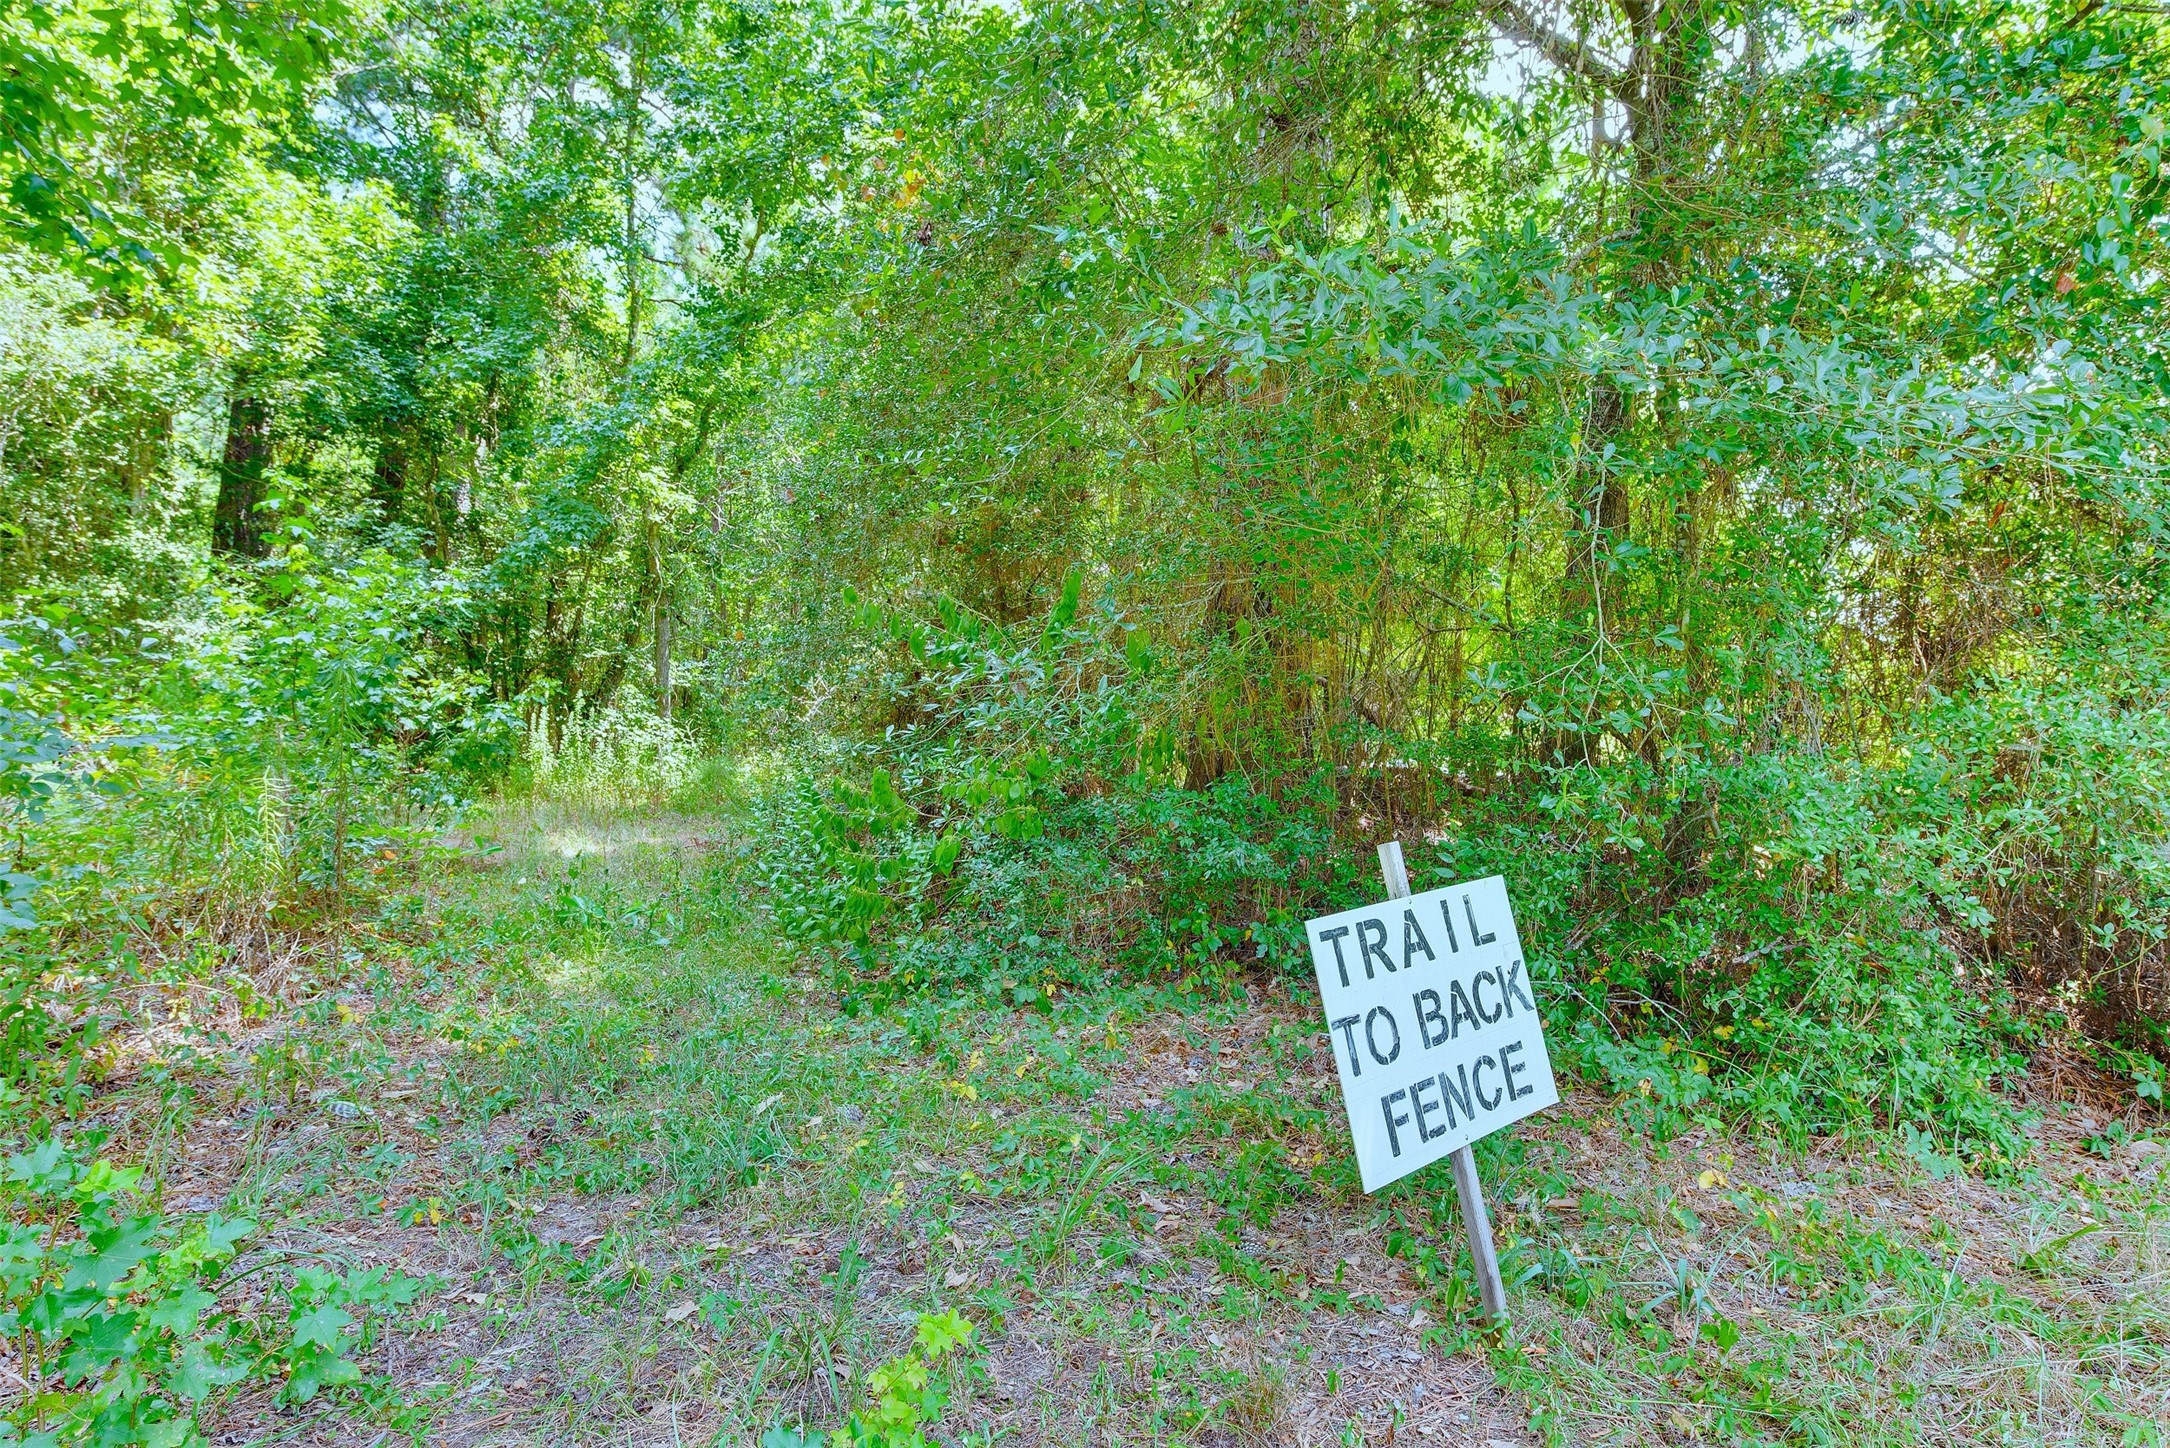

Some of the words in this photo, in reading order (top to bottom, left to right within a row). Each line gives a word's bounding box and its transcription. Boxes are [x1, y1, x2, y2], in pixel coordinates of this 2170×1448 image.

[1319, 894, 1497, 988] TRAIL
[1330, 1005, 1402, 1077] TO
[1411, 960, 1536, 1049] BACK
[1380, 1040, 1534, 1158] FENCE
